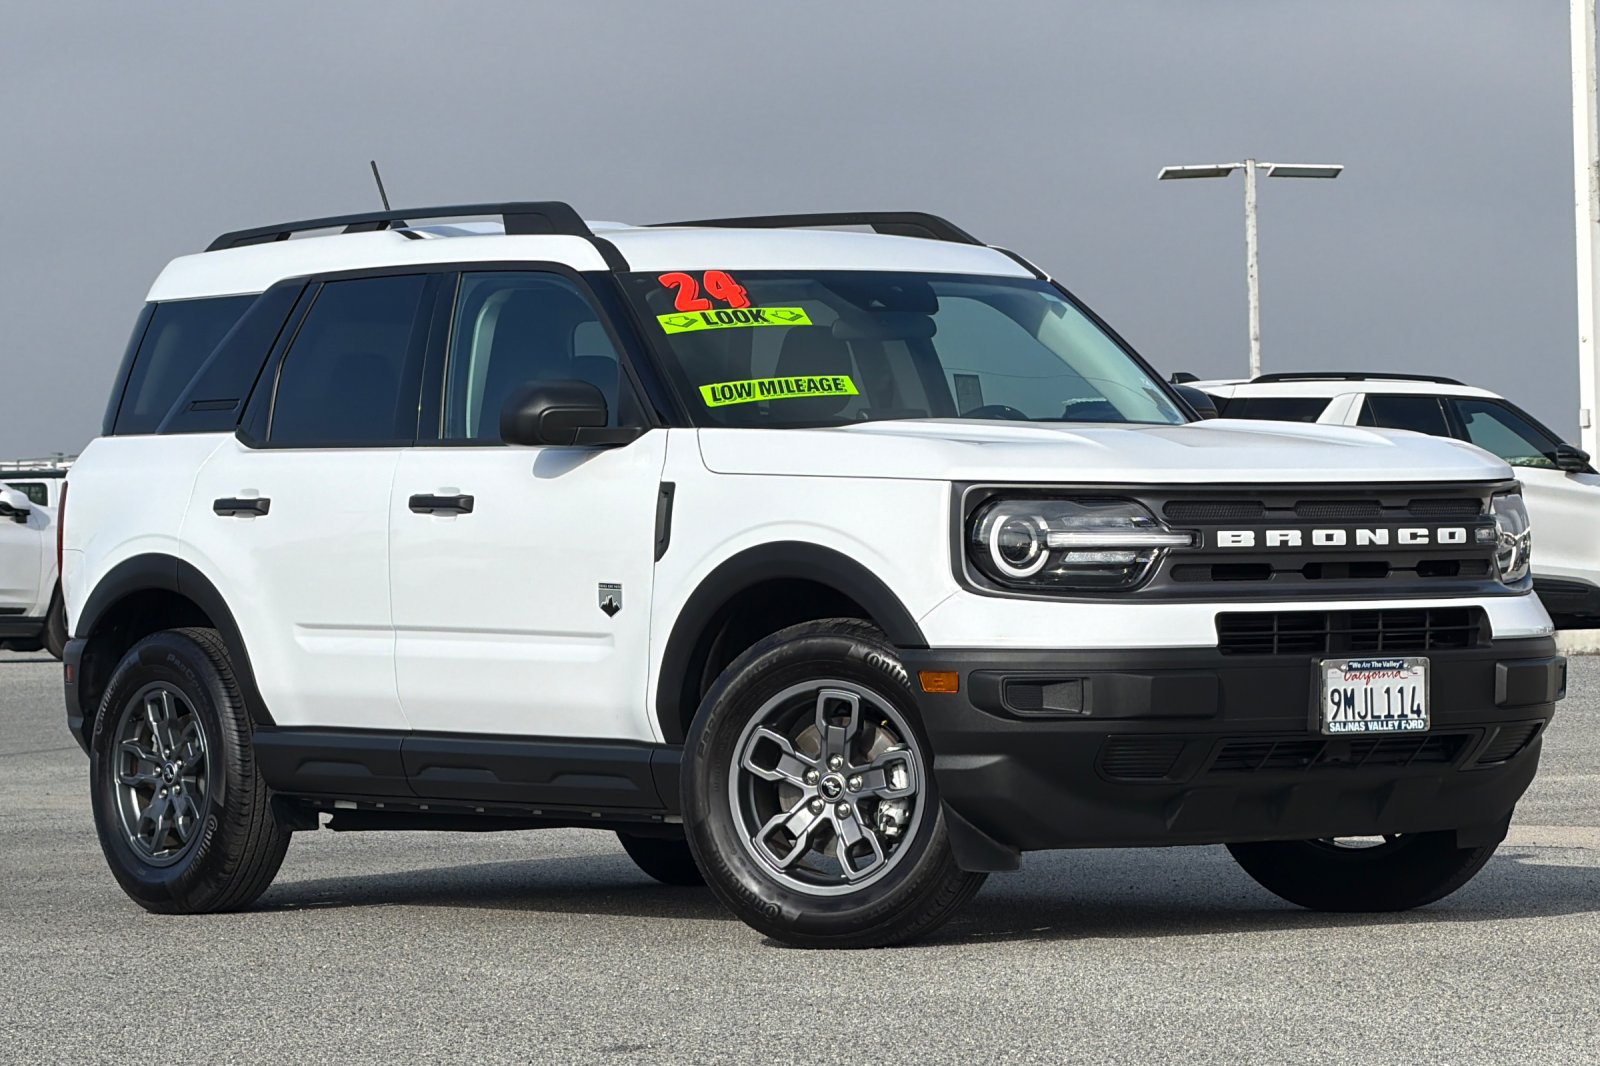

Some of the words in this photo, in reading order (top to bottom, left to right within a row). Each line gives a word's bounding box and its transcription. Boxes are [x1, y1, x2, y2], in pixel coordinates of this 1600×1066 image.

[658, 270, 750, 312] 24
[700, 309, 771, 327] LOOK
[711, 383, 754, 402] LOW
[758, 377, 847, 396] MILEAGE
[1217, 527, 1467, 548] BRONCO
[1371, 660, 1382, 668] The
[1344, 670, 1409, 686] California
[1330, 686, 1422, 720] 9MJL114
[1329, 721, 1366, 732] SALINAS
[1367, 720, 1399, 731] VALLEY
[1401, 719, 1425, 730] FORD
